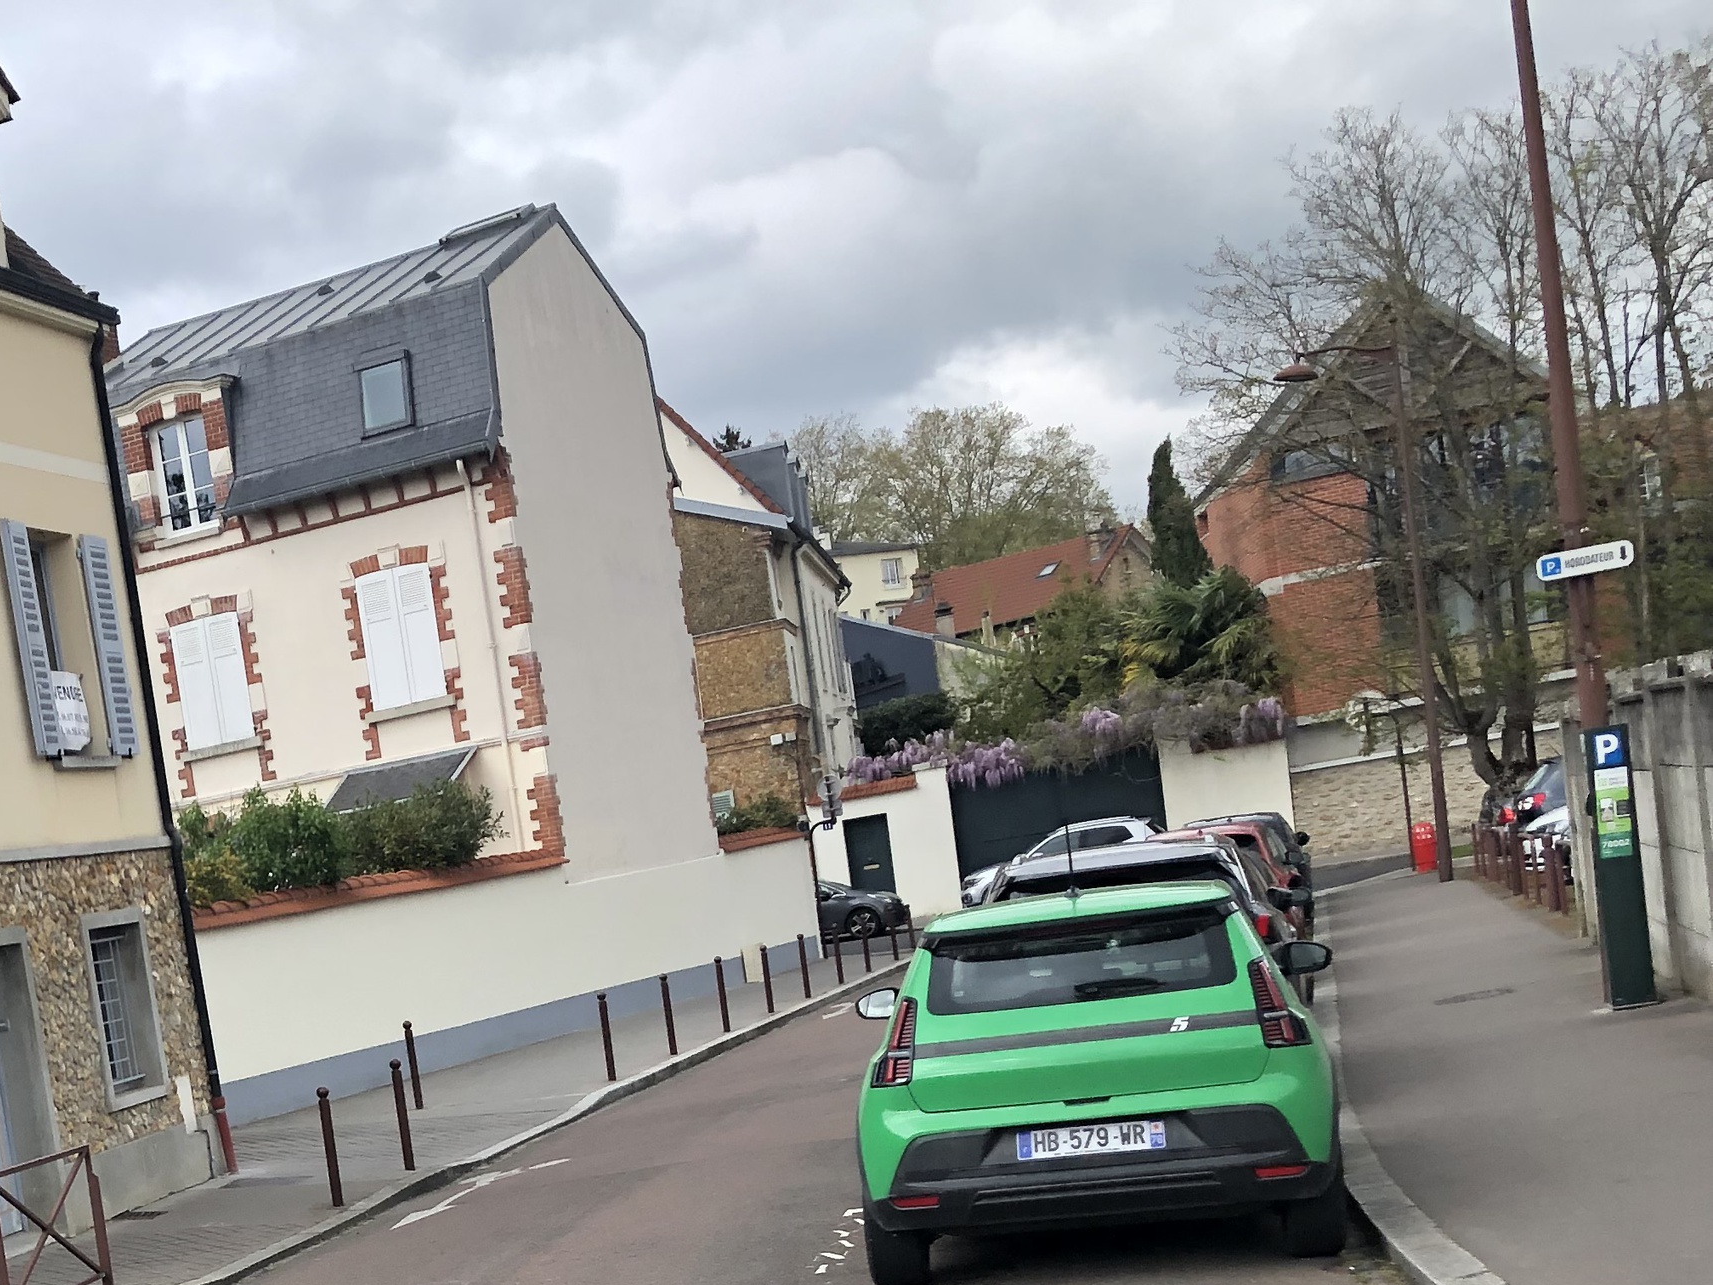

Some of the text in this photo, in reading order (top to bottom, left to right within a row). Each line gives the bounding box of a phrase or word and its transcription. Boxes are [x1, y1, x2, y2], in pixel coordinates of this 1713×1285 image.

[1546, 561, 1556, 573] P
[1595, 733, 1618, 764] P
[1033, 1123, 1146, 1153] HB-579-WR
